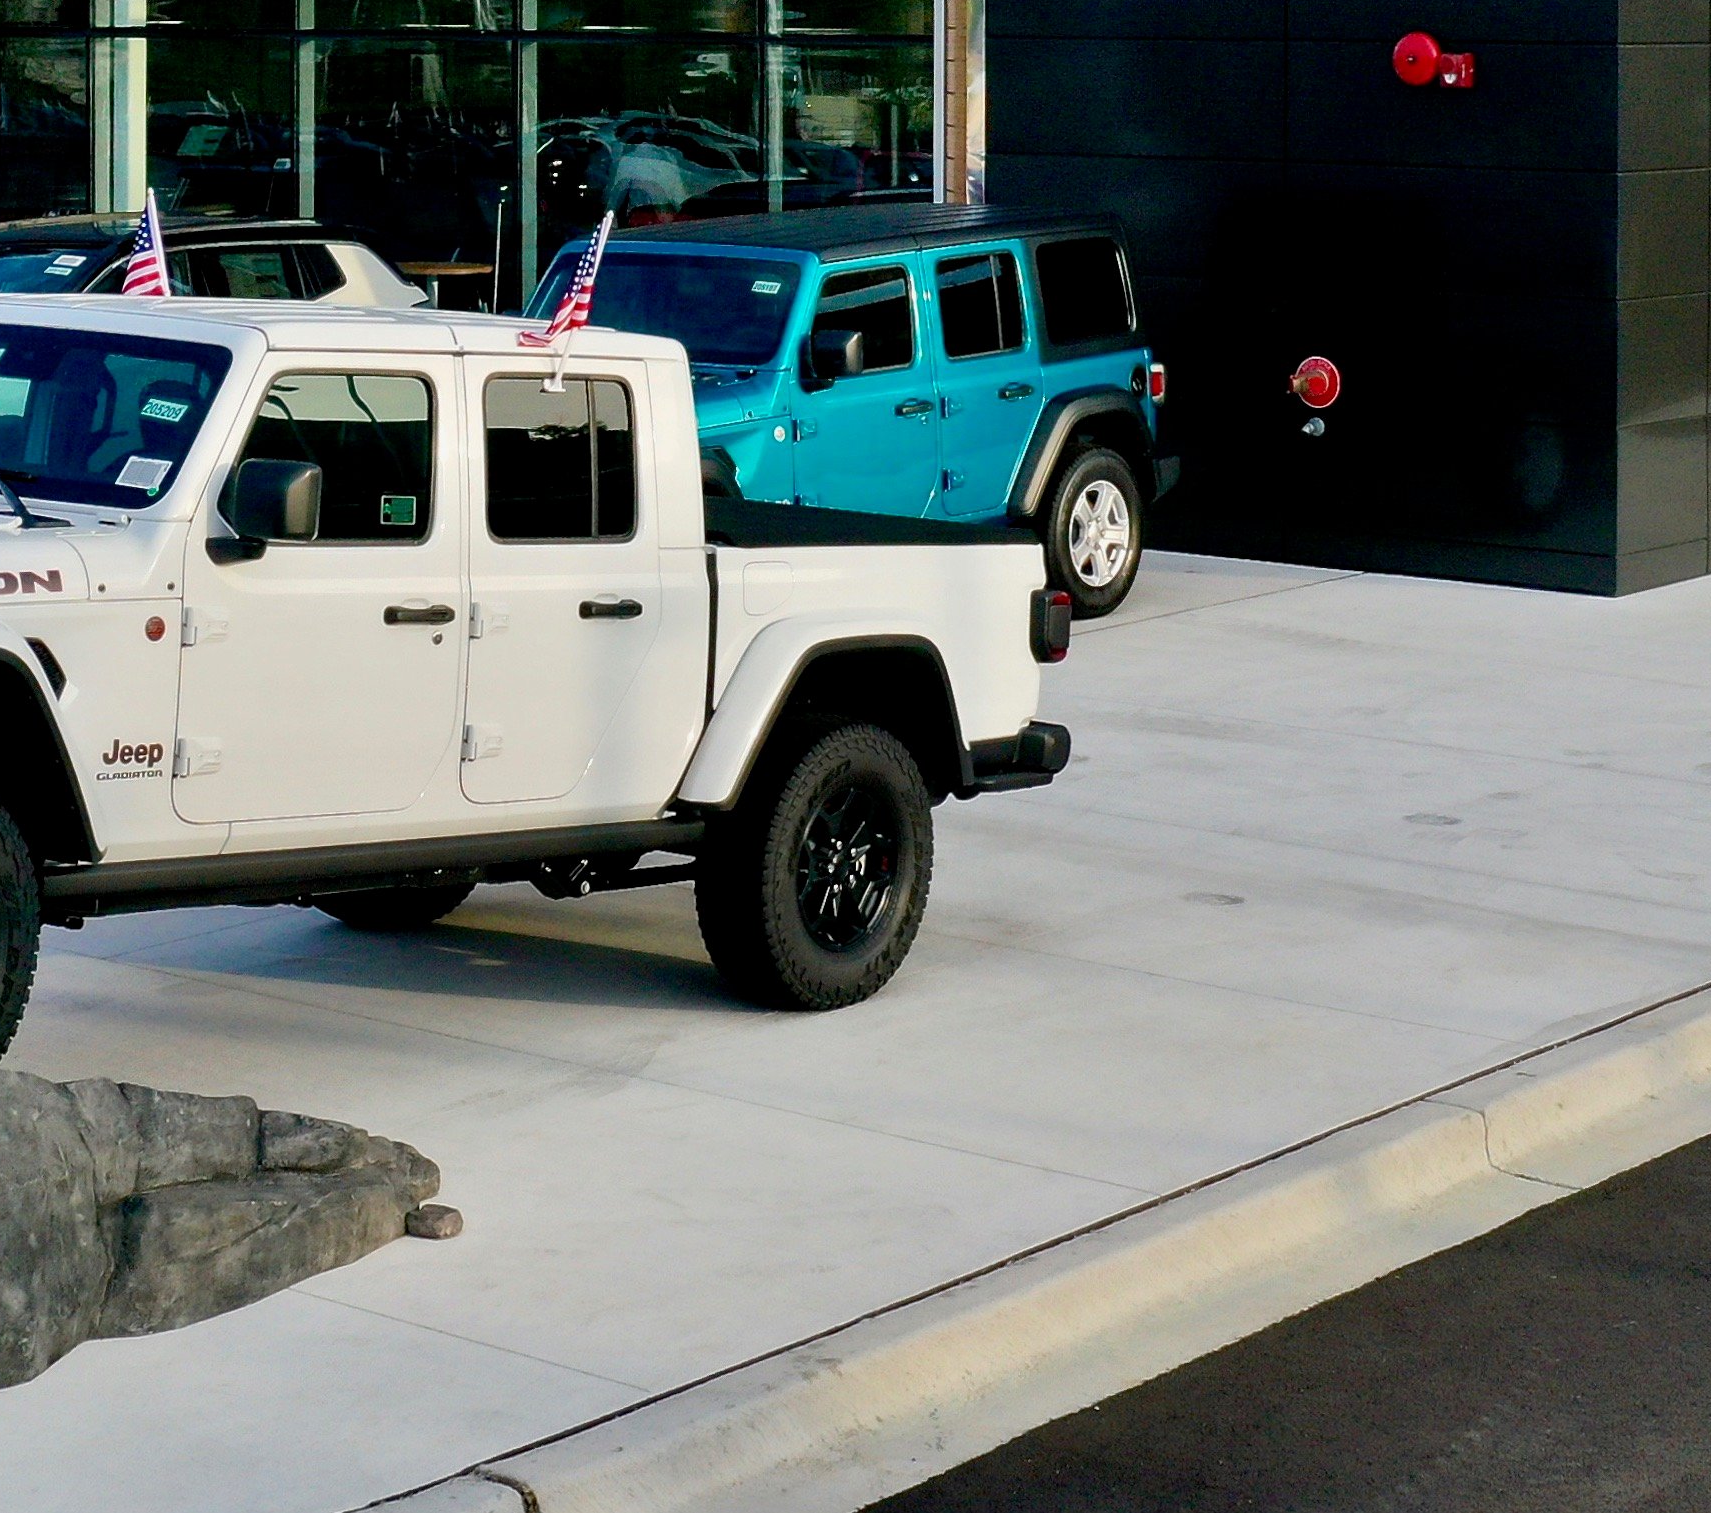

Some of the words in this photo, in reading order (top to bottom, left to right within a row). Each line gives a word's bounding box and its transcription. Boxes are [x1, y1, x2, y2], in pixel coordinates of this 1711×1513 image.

[142, 401, 183, 419] 205209
[102, 738, 164, 768] Jeep
[96, 769, 163, 781] GLADIATOR
